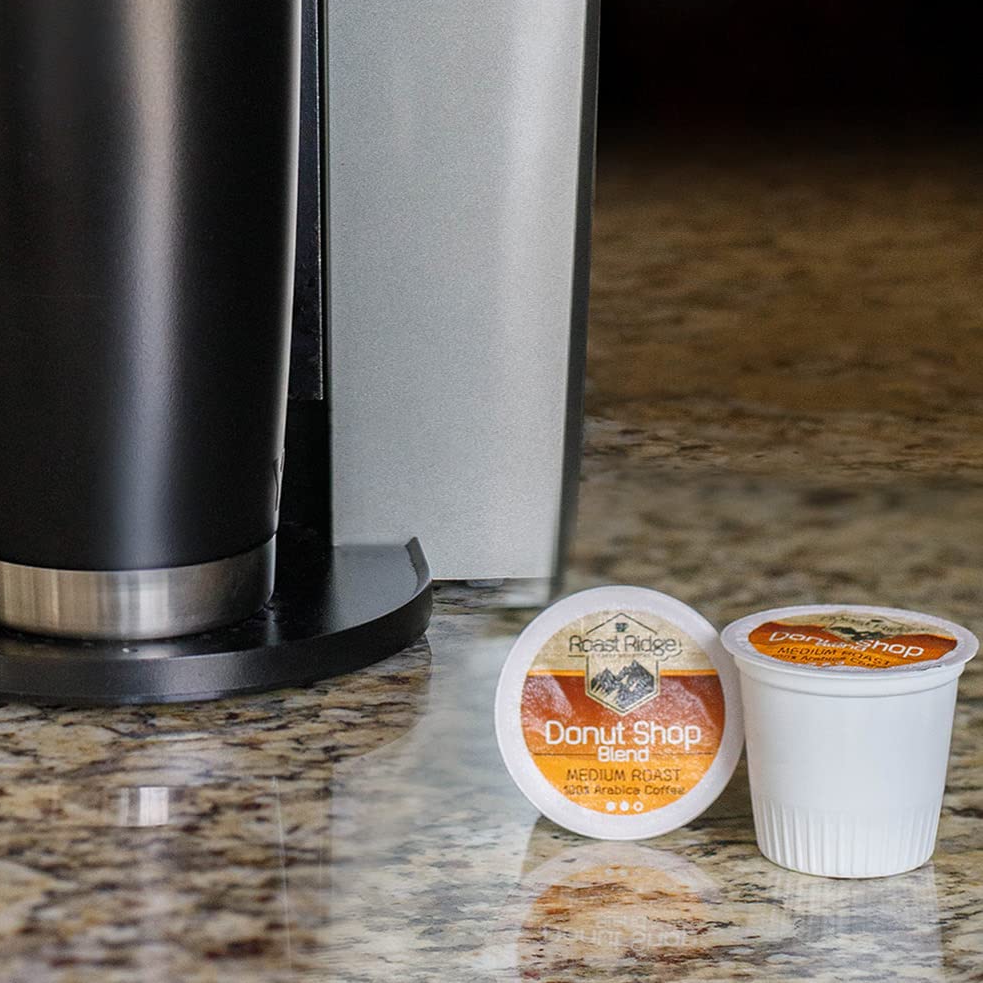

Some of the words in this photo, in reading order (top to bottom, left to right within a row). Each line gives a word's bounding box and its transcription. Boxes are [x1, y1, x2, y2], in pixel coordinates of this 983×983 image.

[569, 635, 619, 652] Roast
[624, 635, 677, 656] Ridge
[778, 647, 837, 656] MEDIUM
[855, 639, 925, 658] Shop
[545, 720, 626, 745] Donut
[633, 720, 702, 752] Shop
[597, 746, 650, 762] Blend
[566, 768, 626, 782] MEDIUM
[631, 768, 682, 782] ROAST
[594, 784, 641, 795] Arabica
[644, 784, 685, 795] Coffee
